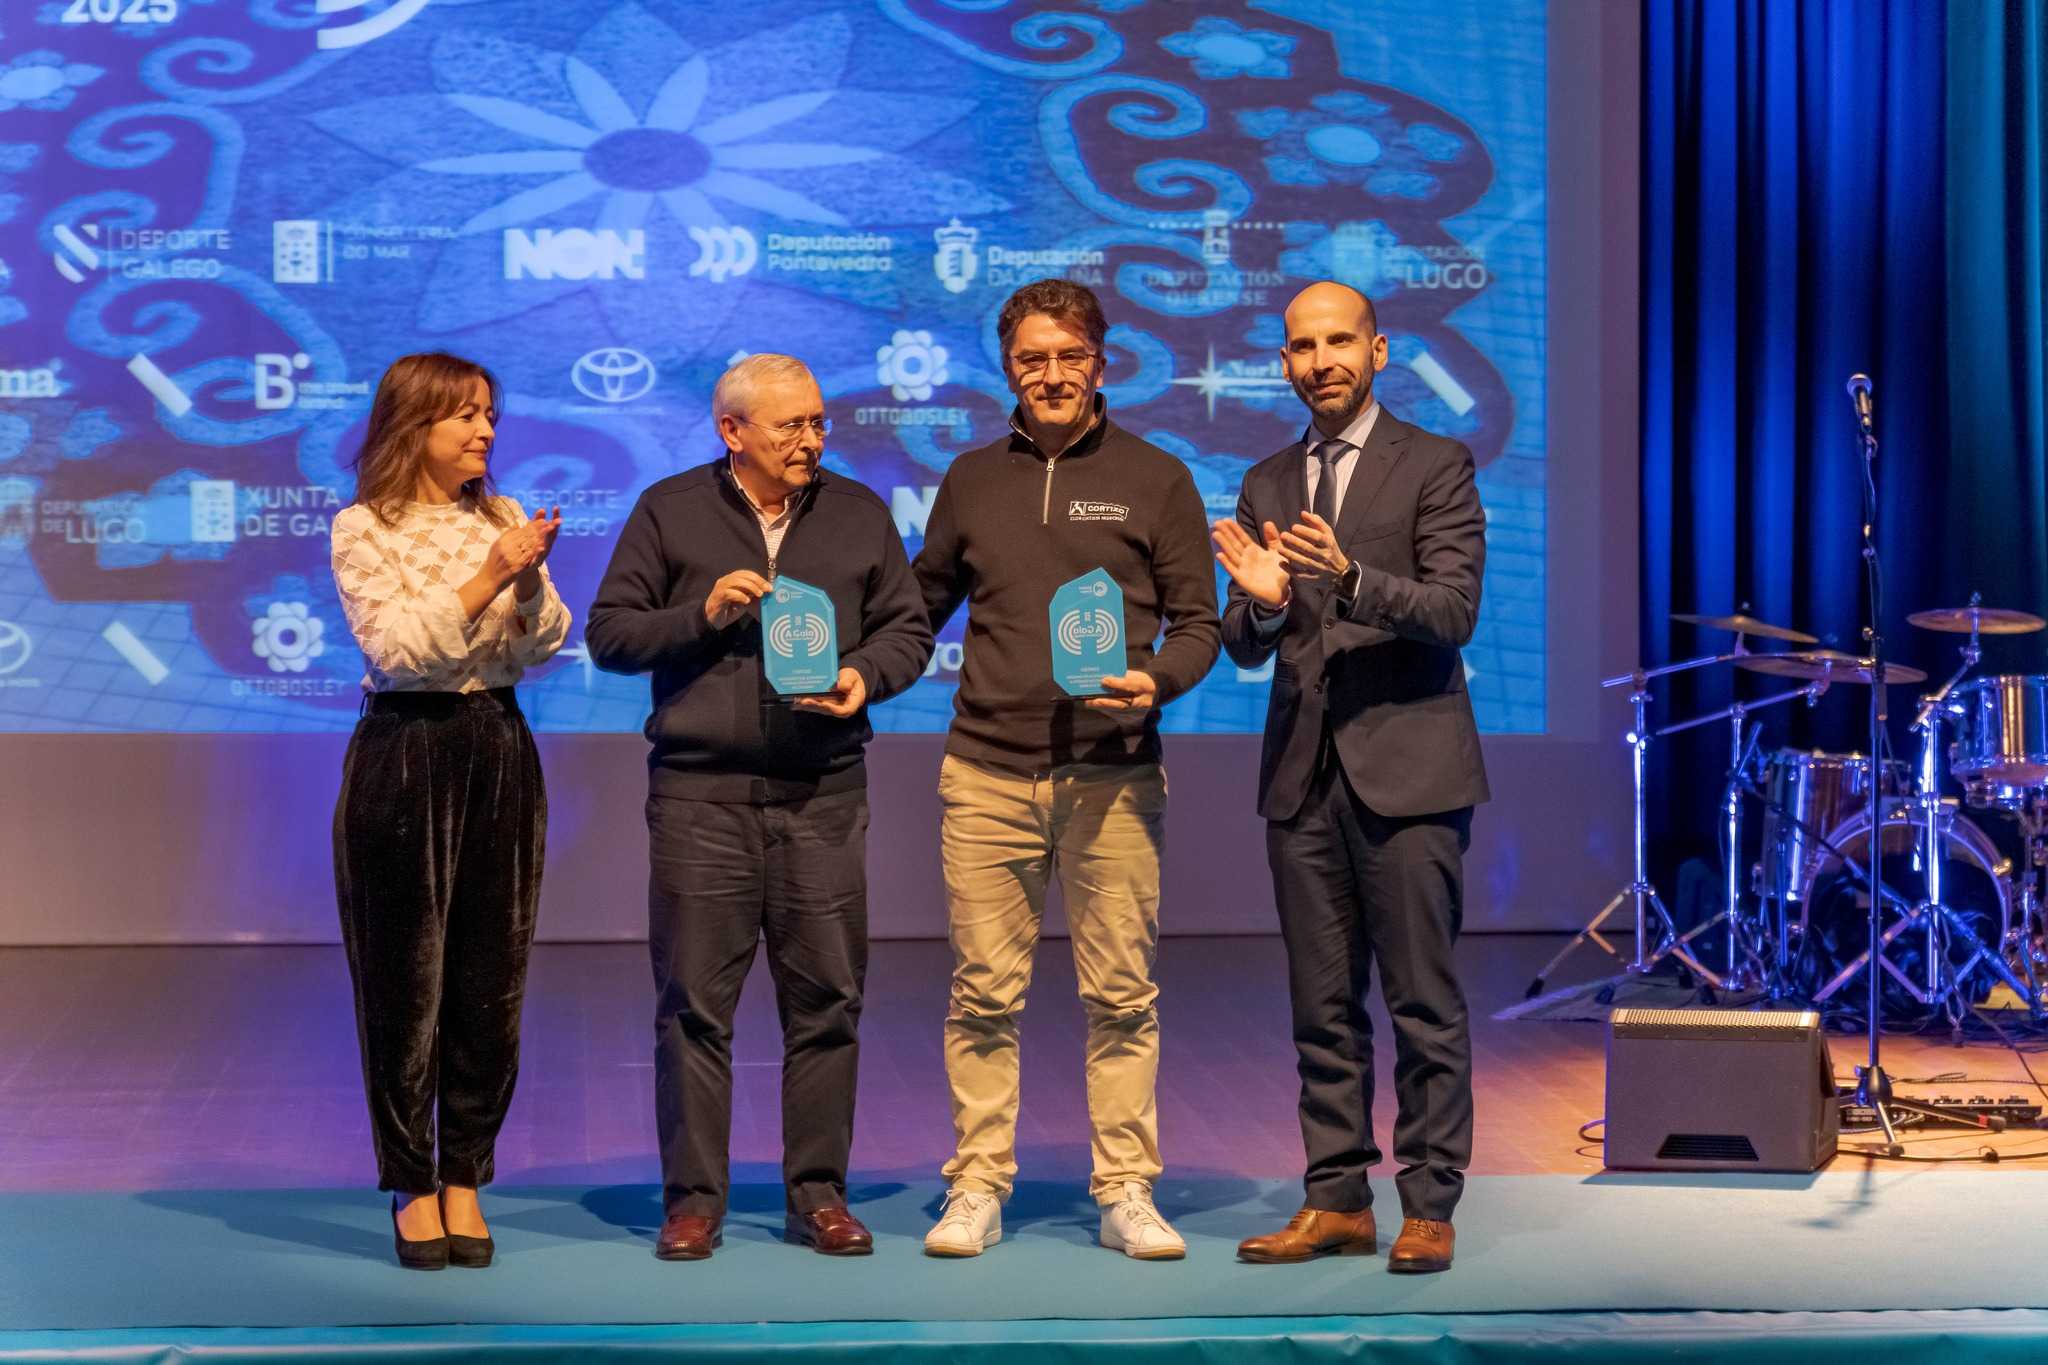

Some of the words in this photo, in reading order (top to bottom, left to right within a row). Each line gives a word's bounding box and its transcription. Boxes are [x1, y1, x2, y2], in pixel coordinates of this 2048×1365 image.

[121, 229, 231, 250] DEPORTE
[123, 259, 221, 279] GALEGO
[1406, 263, 1487, 289] LUGO
[245, 485, 339, 509] XUNTA
[66, 518, 146, 544] LUGO
[245, 513, 281, 537] DE
